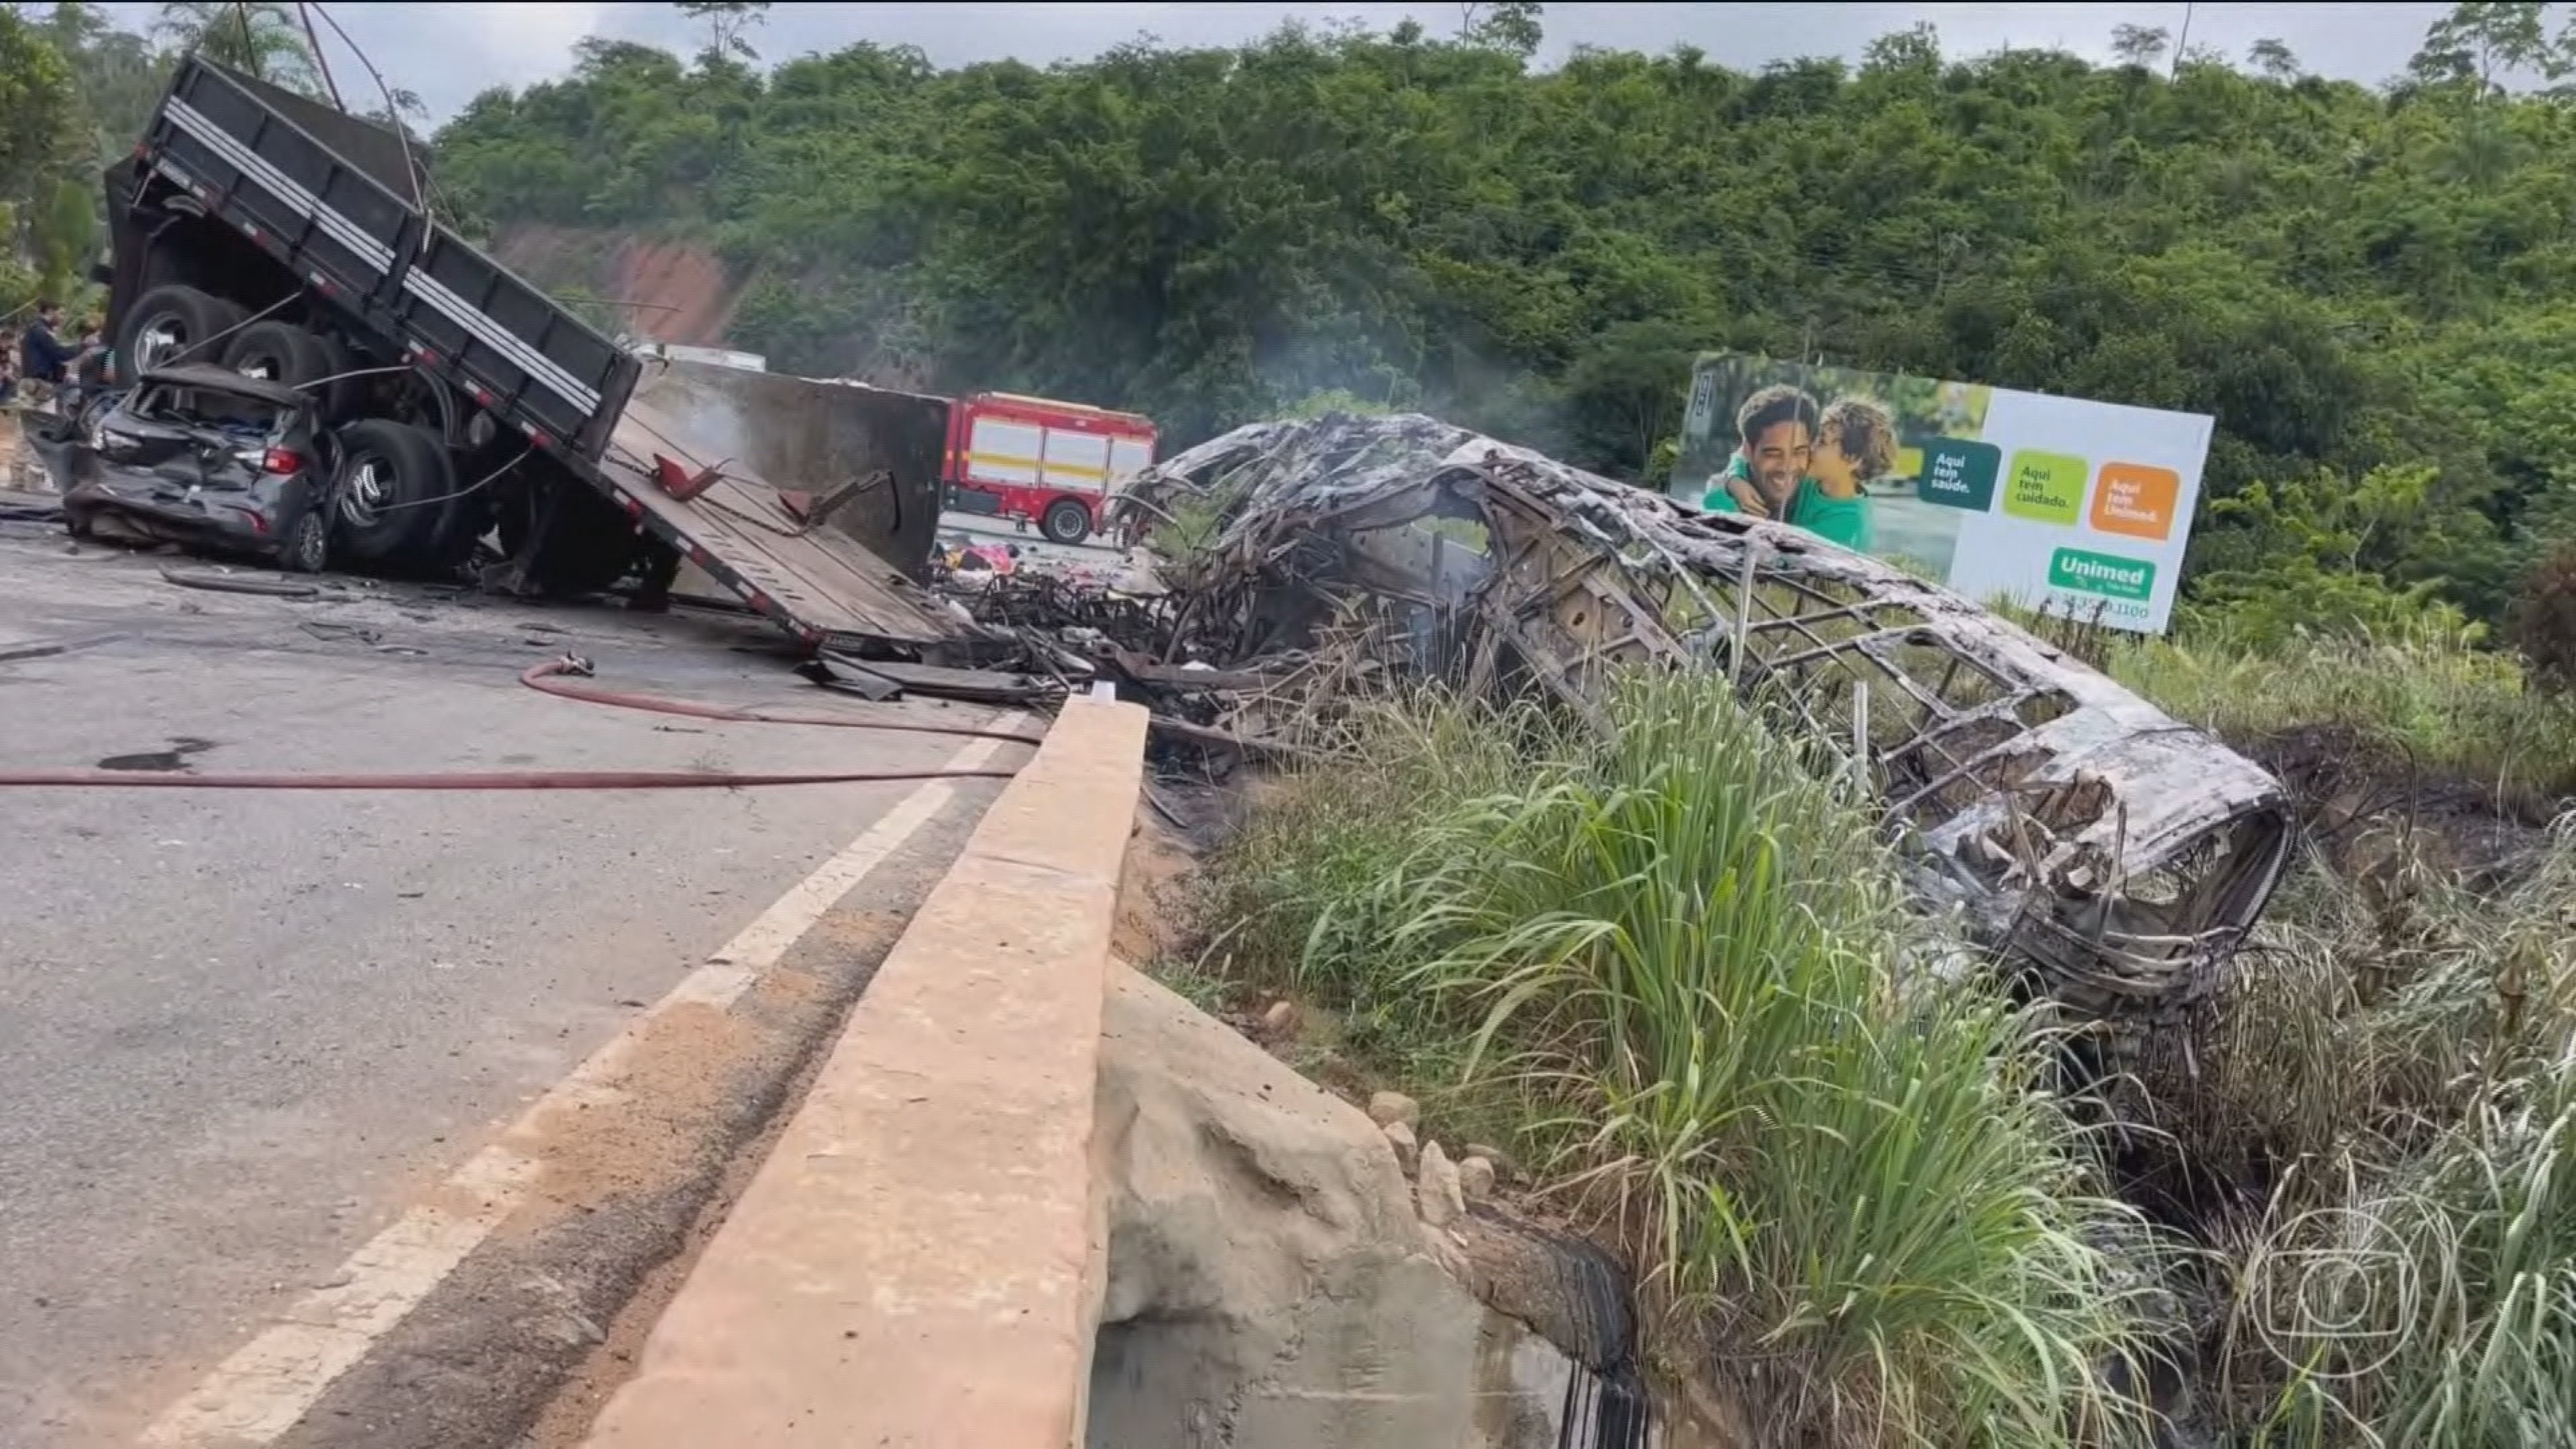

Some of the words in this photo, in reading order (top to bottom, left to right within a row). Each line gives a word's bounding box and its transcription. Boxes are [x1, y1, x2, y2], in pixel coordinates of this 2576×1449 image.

[1936, 452, 1966, 470] Aqui
[1934, 466, 1958, 478] tem
[2021, 466, 2050, 482] Aqui
[1931, 476, 1970, 494] saúde.
[2019, 479, 2043, 491] tem
[2108, 478, 2141, 495] Aqui
[2015, 492, 2068, 508] cuidado.
[2106, 492, 2133, 506] tem
[2061, 557, 2145, 585] Unimed
